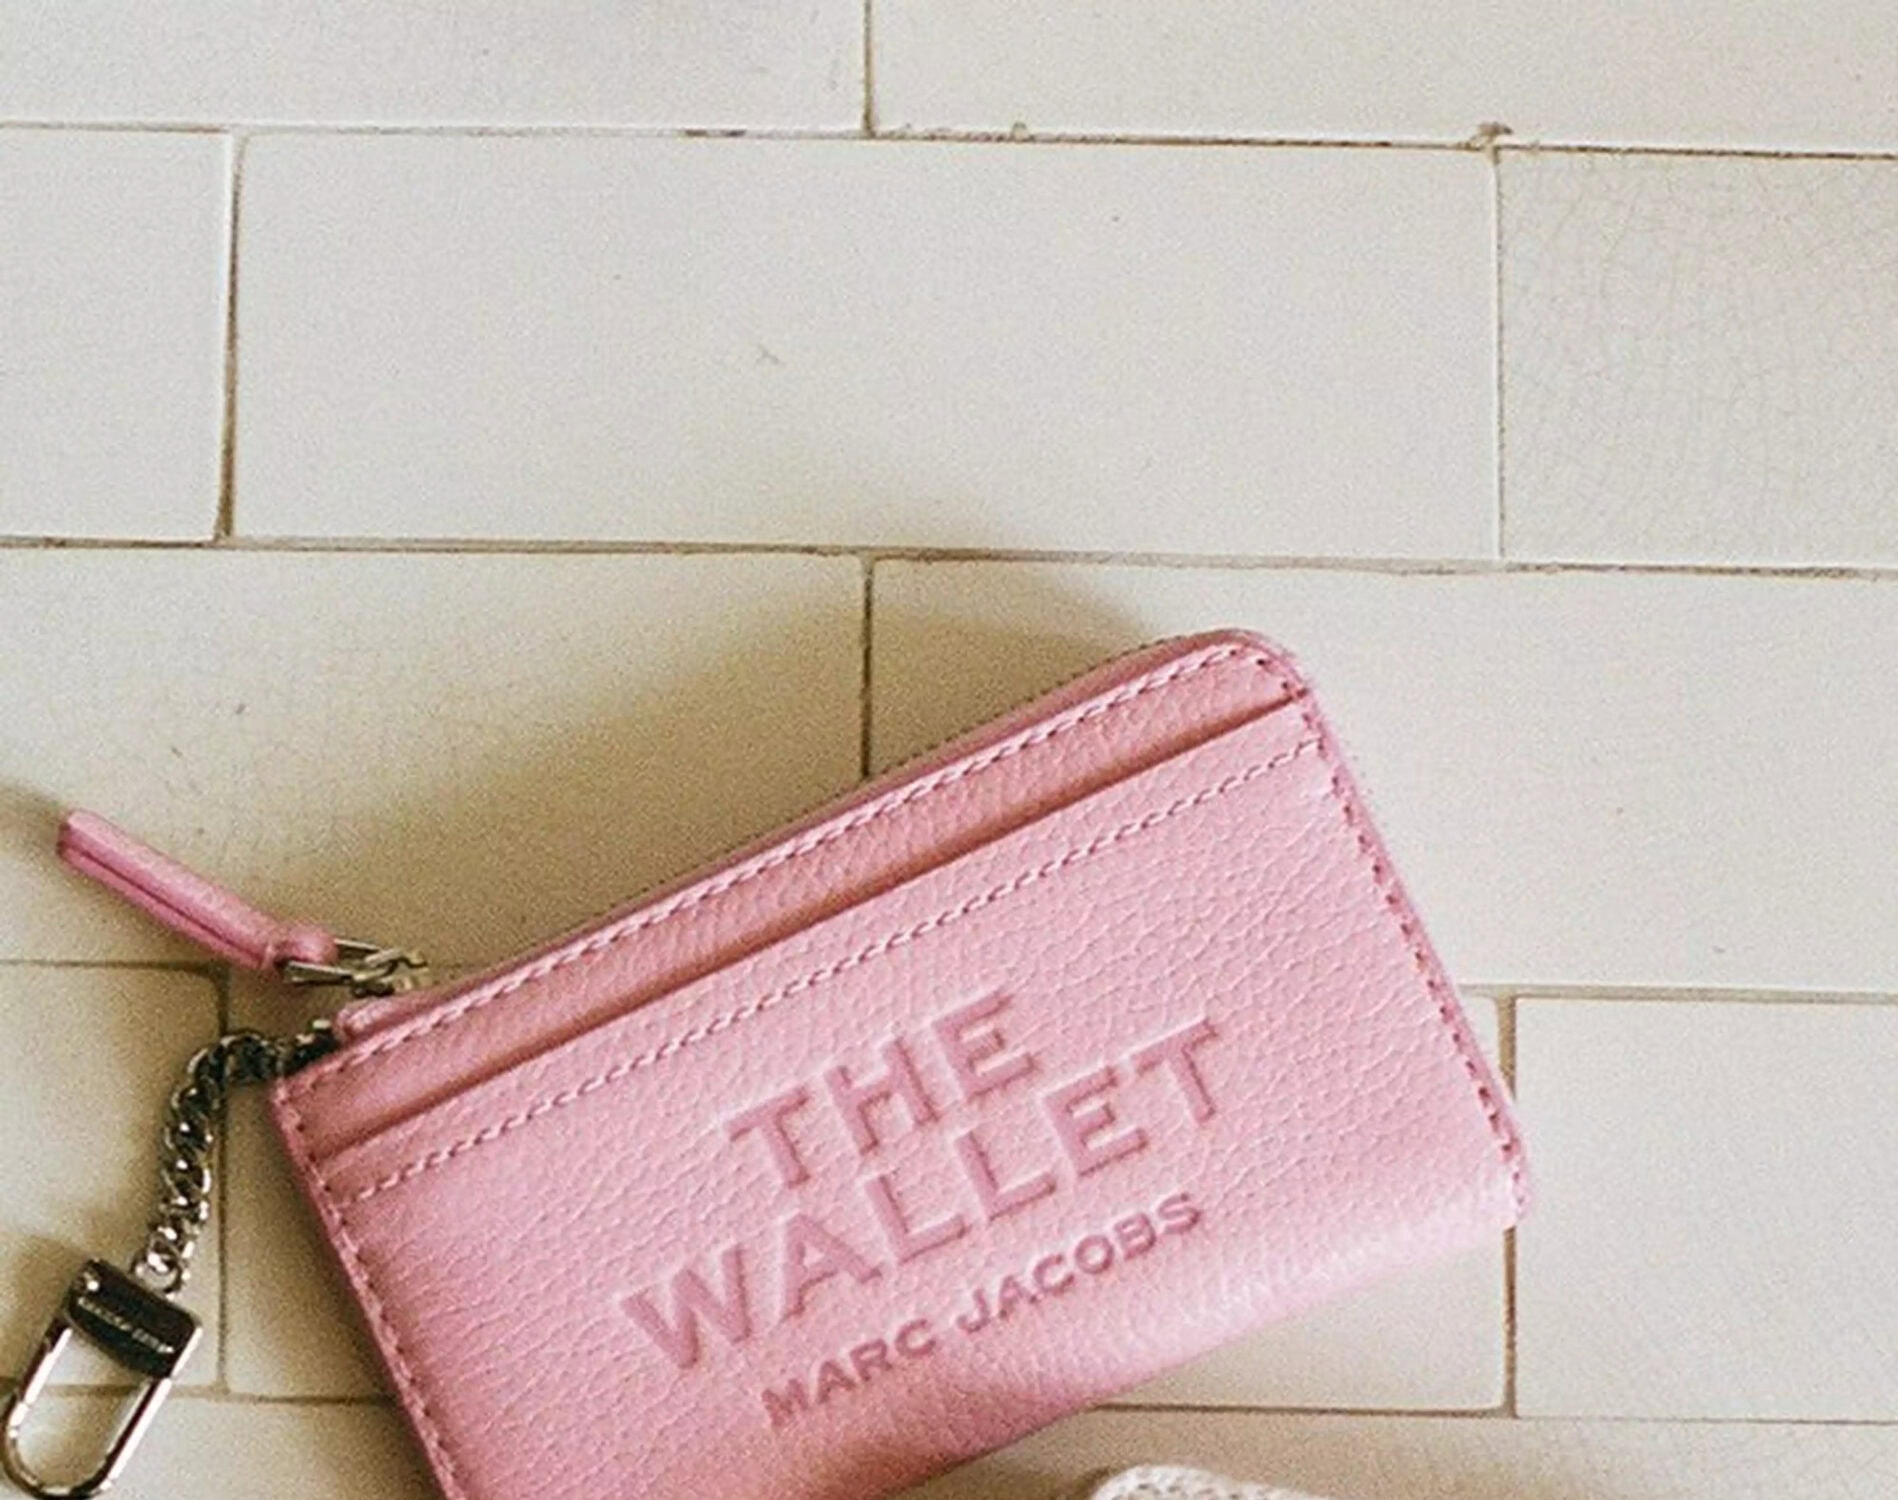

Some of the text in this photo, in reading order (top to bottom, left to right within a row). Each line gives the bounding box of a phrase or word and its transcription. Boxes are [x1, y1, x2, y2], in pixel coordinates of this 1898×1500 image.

[620, 1017, 1220, 1369] WALLET
[726, 993, 1039, 1190] THE
[761, 1192, 1202, 1428] MARC JACOBS
